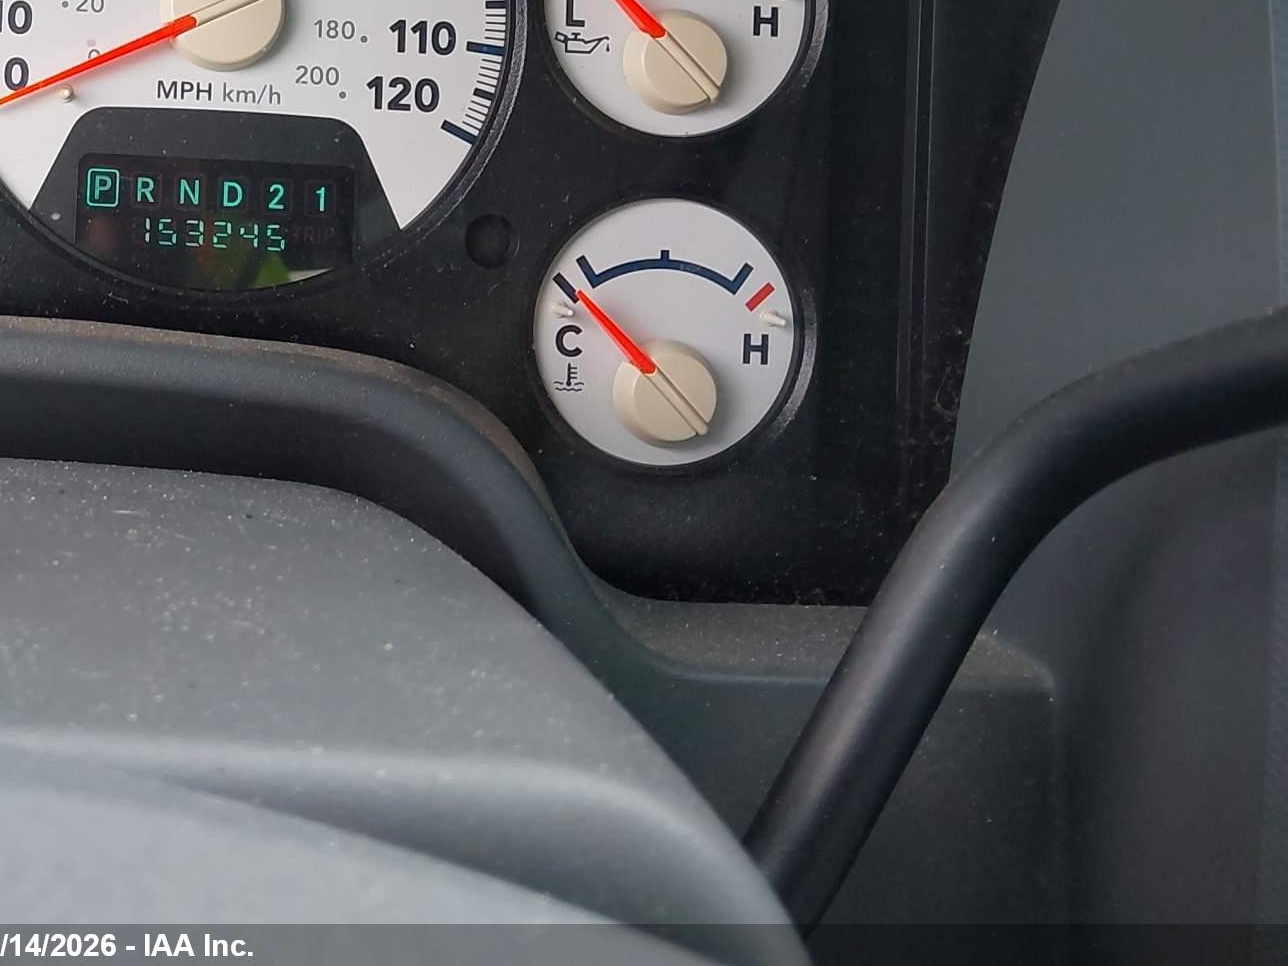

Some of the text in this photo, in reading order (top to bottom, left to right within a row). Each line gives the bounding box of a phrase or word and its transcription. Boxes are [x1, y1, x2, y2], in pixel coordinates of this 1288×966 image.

[314, 20, 355, 39] 180
[390, 20, 456, 55] 110
[753, 6, 778, 37] H
[4, 57, 29, 91] 0
[296, 66, 339, 85] 200
[158, 80, 280, 105] MPH km/h
[367, 76, 439, 112] 120
[94, 175, 325, 210] P R N D 2 1
[144, 218, 286, 252] 153245
[556, 325, 582, 357] C
[743, 334, 768, 365] H
